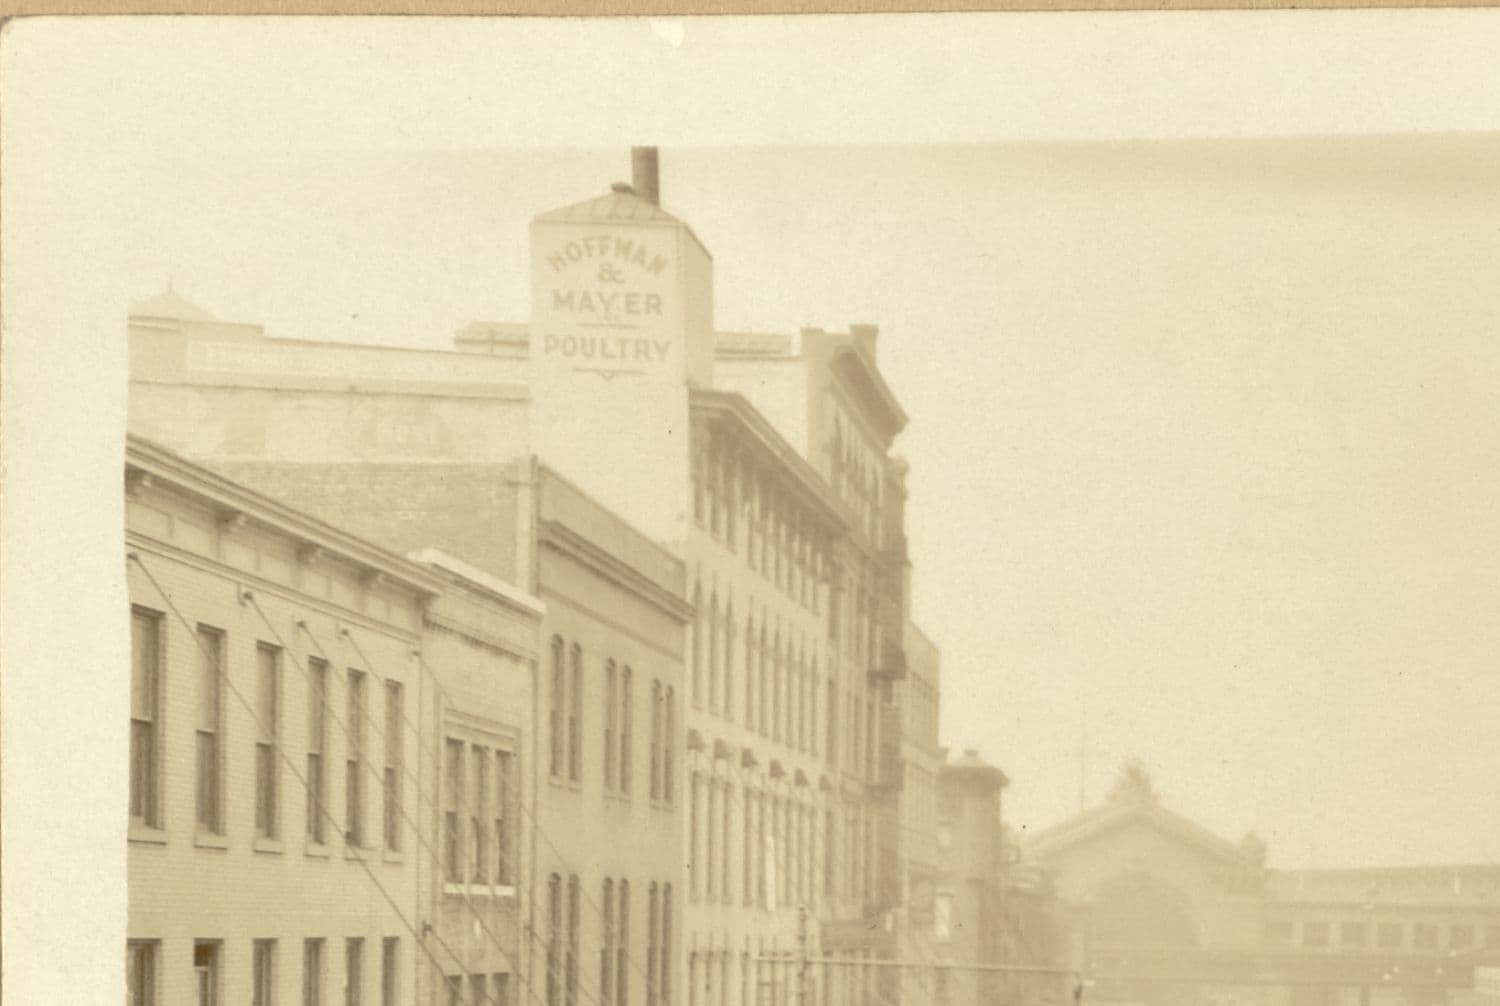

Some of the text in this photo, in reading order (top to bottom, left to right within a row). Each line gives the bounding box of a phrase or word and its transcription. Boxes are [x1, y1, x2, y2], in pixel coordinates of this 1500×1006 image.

[546, 235, 669, 277] HOFFMAN
[597, 261, 625, 284] &
[551, 288, 664, 316] MAYER
[543, 334, 672, 361] POULTRY
